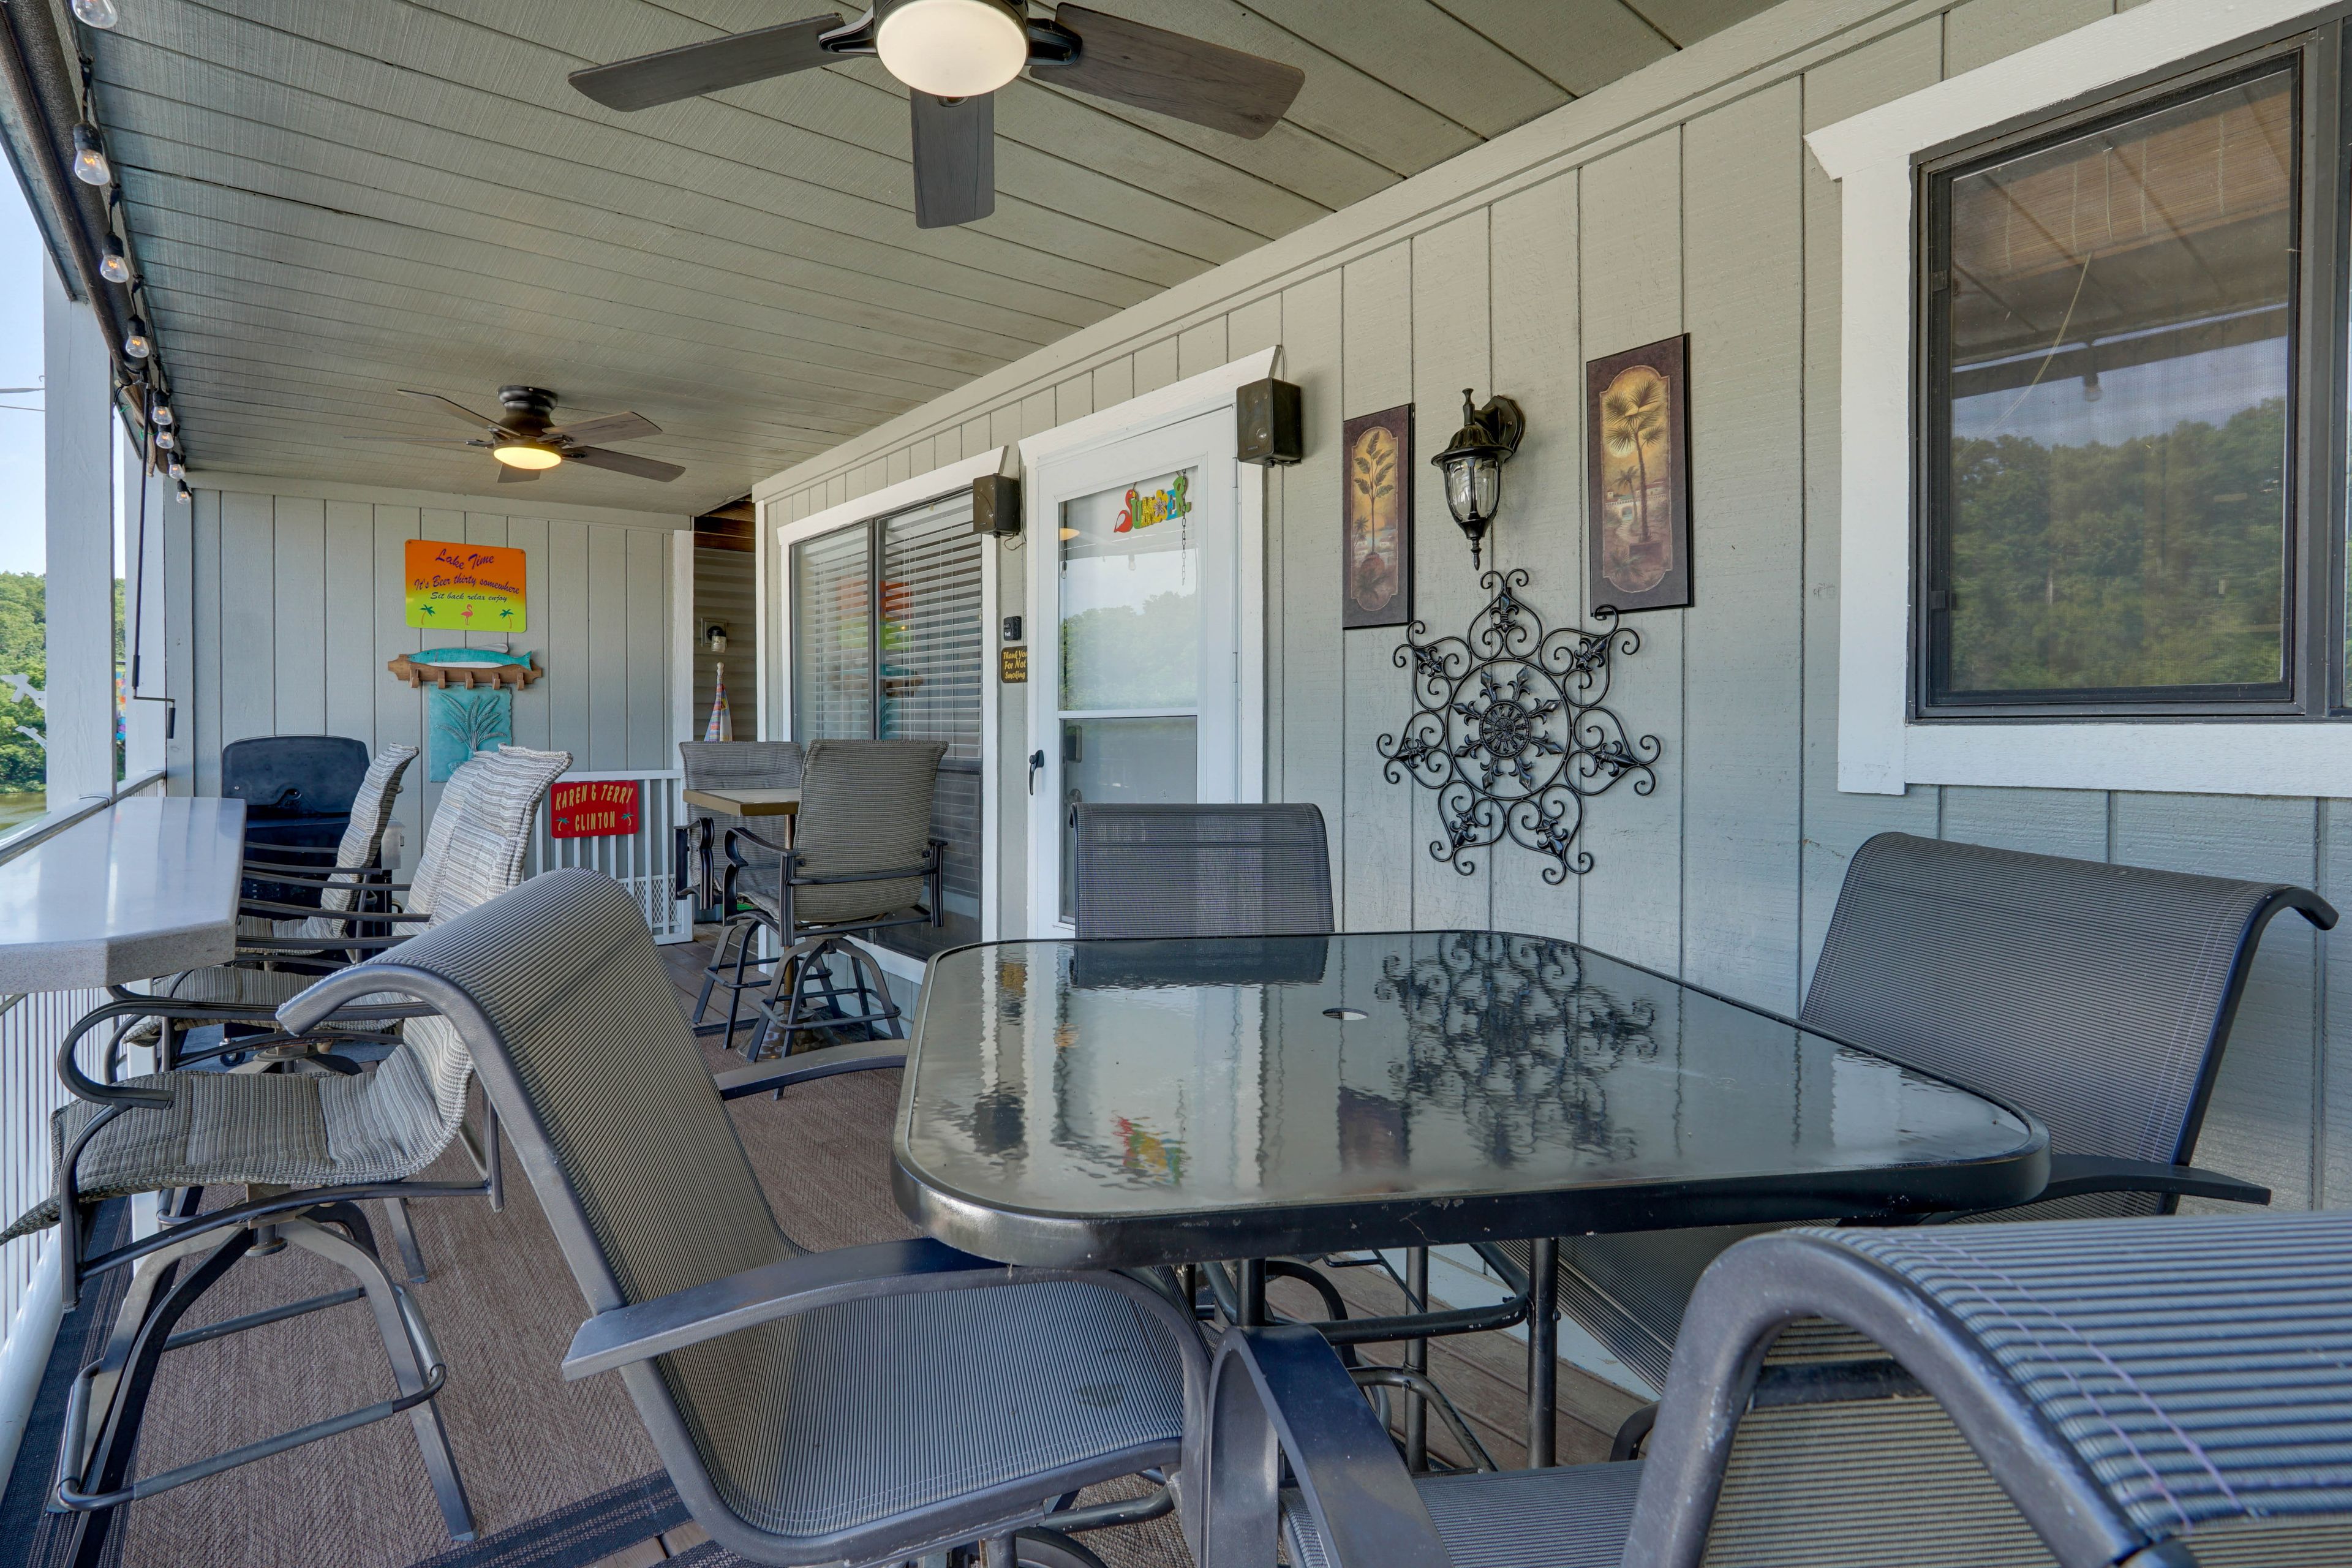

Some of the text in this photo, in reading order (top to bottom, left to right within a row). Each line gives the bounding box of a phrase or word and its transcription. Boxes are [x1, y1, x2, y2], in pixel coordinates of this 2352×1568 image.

[1114, 476, 1192, 533] SUMER
[435, 548, 495, 570] Lake Time
[414, 573, 520, 595] It's Beer thirty somewhere
[430, 592, 444, 600] Sit
[1003, 650, 1018, 660] Thank
[1005, 660, 1027, 670] For Not
[1005, 671, 1025, 680] Smoking
[556, 784, 634, 811] KAREN & TERRY
[575, 811, 616, 832] CLINTON
